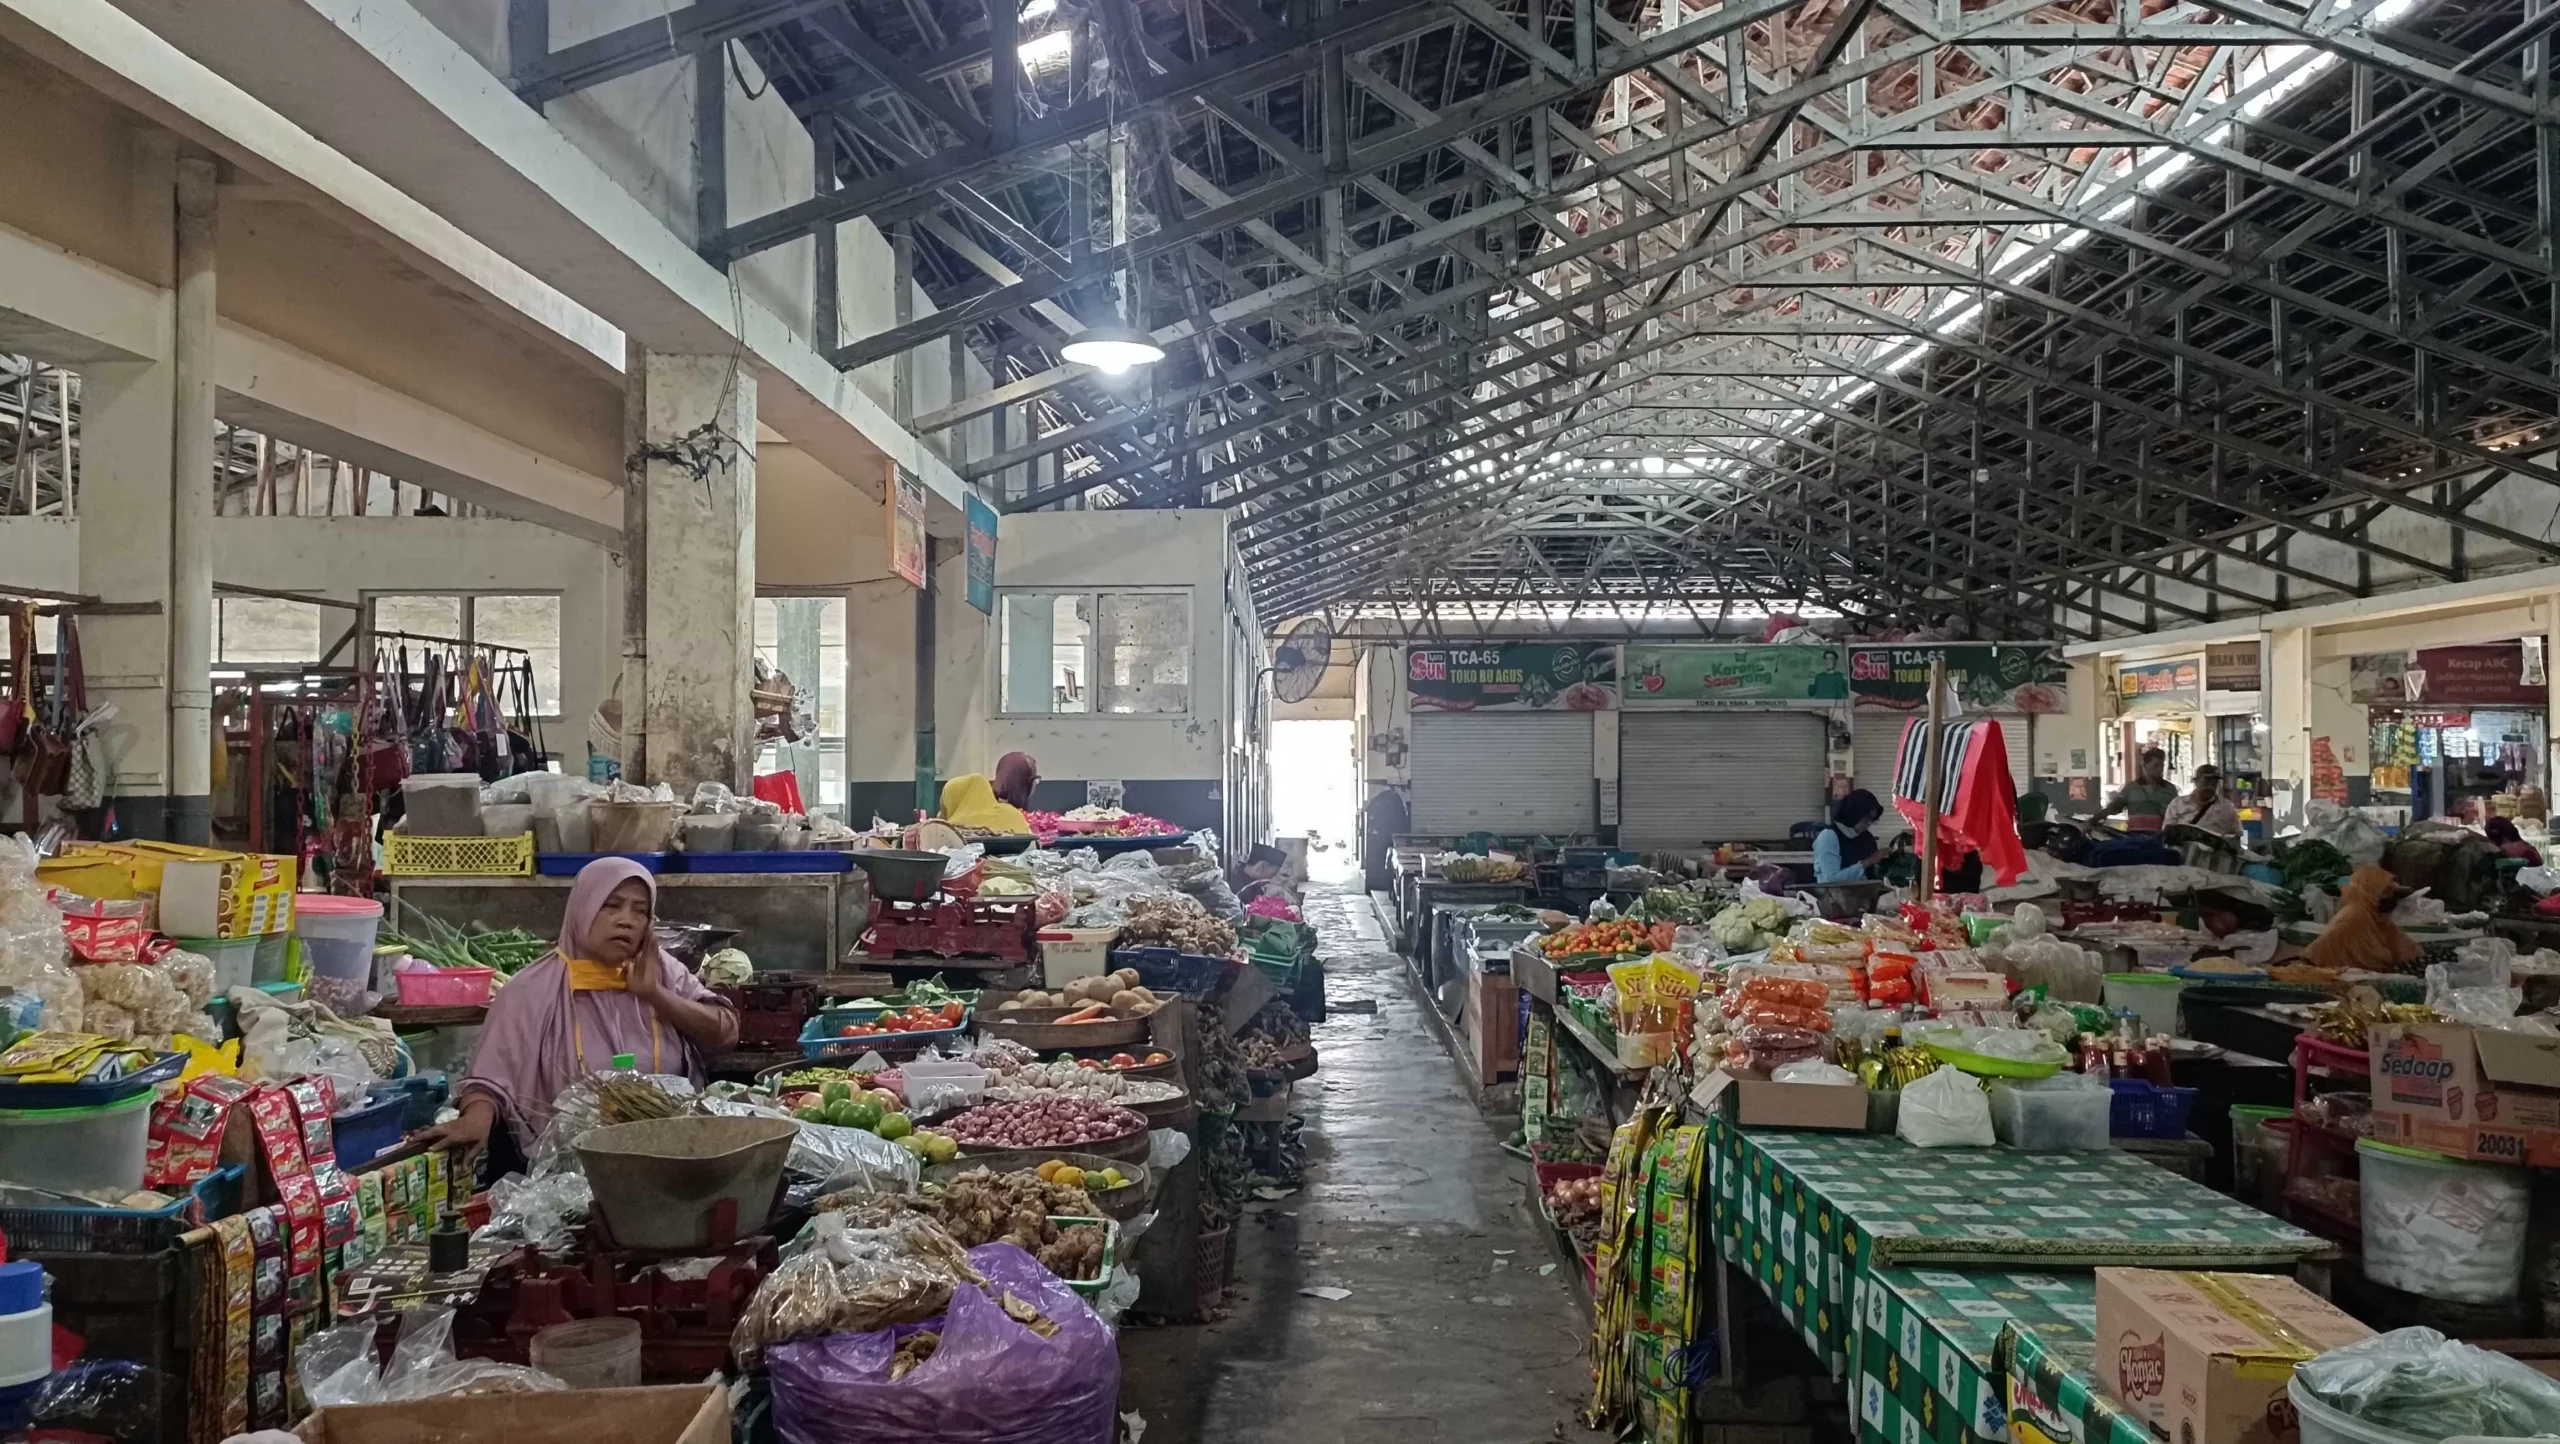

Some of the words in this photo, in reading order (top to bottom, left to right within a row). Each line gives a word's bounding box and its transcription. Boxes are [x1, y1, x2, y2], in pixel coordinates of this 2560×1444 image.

[1449, 650, 1500, 665] TCA-65
[2448, 657, 2482, 671] Kecap
[2484, 657, 2509, 668] ABC
[1450, 669, 1477, 683] TOKO
[1479, 669, 1494, 683] BU
[1495, 668, 1523, 683] AGUS
[1893, 669, 1922, 683] TOKO
[2381, 1053, 2455, 1084] Sedaap
[2477, 1132, 2525, 1156] 20031
[2120, 1347, 2163, 1400] Konjac
